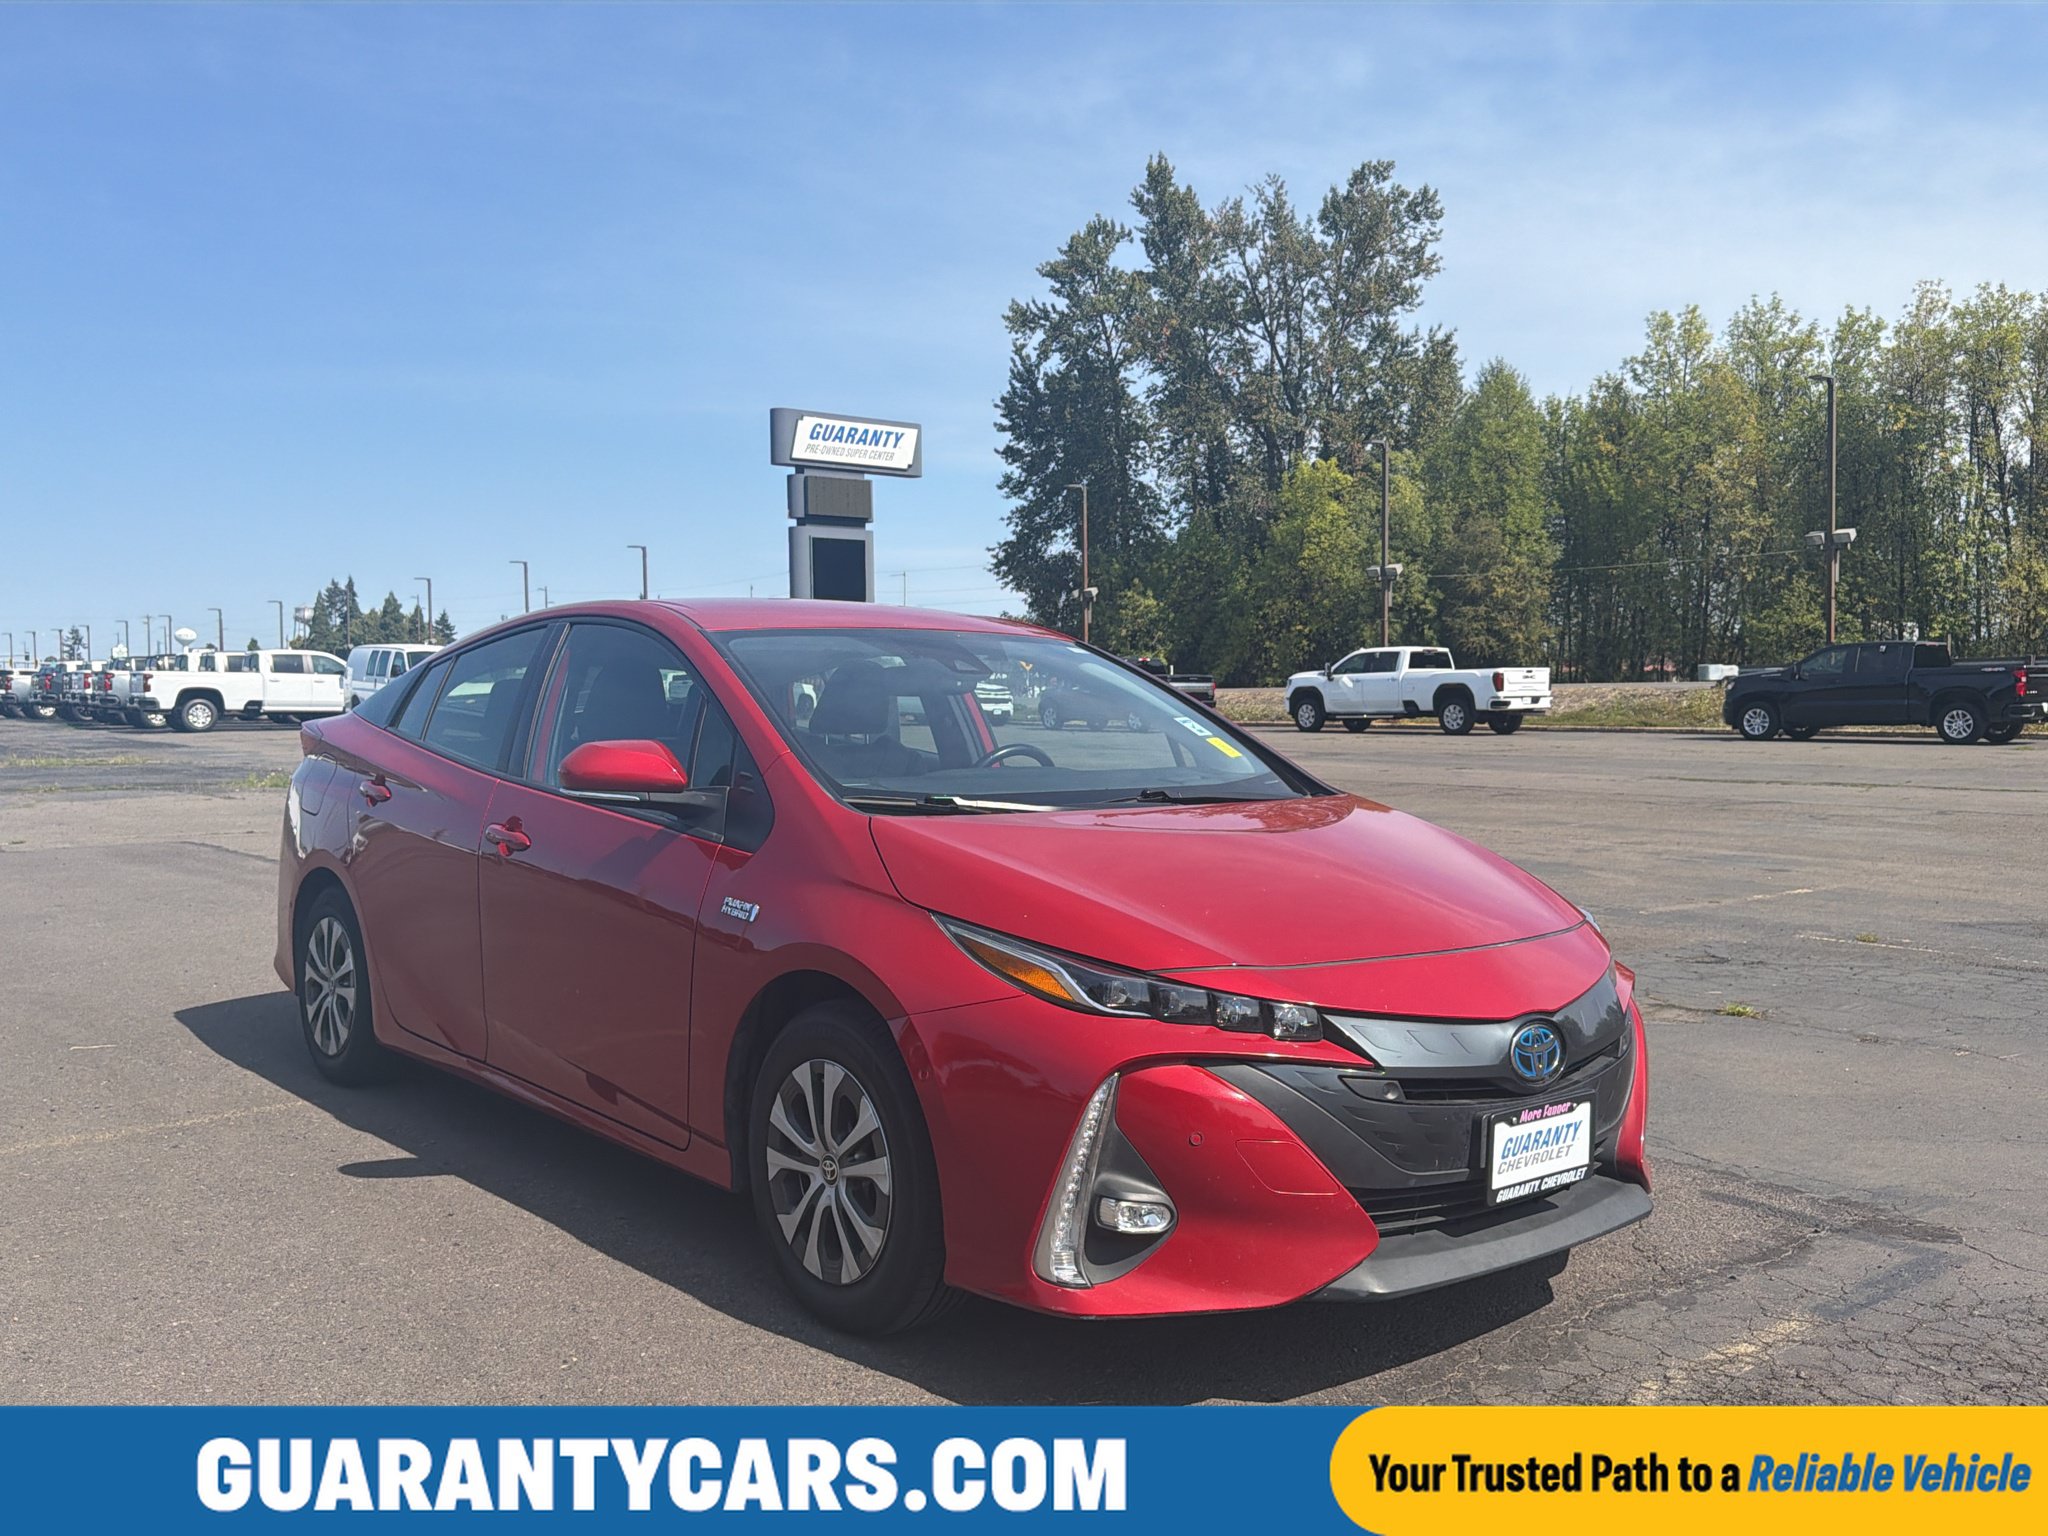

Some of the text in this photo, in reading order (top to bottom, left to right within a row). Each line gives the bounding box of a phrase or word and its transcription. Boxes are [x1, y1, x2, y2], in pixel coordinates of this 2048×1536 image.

[809, 423, 905, 449] GUARANTY
[804, 443, 895, 461] PRE-OWNED SUPER CENTER
[721, 905, 749, 919] HYBRID
[1519, 1108, 1542, 1123] More
[1501, 1120, 1583, 1160] GUARANTY
[1497, 1144, 1573, 1175] CHEVROLET
[1541, 1167, 1588, 1190] CHEVROLET
